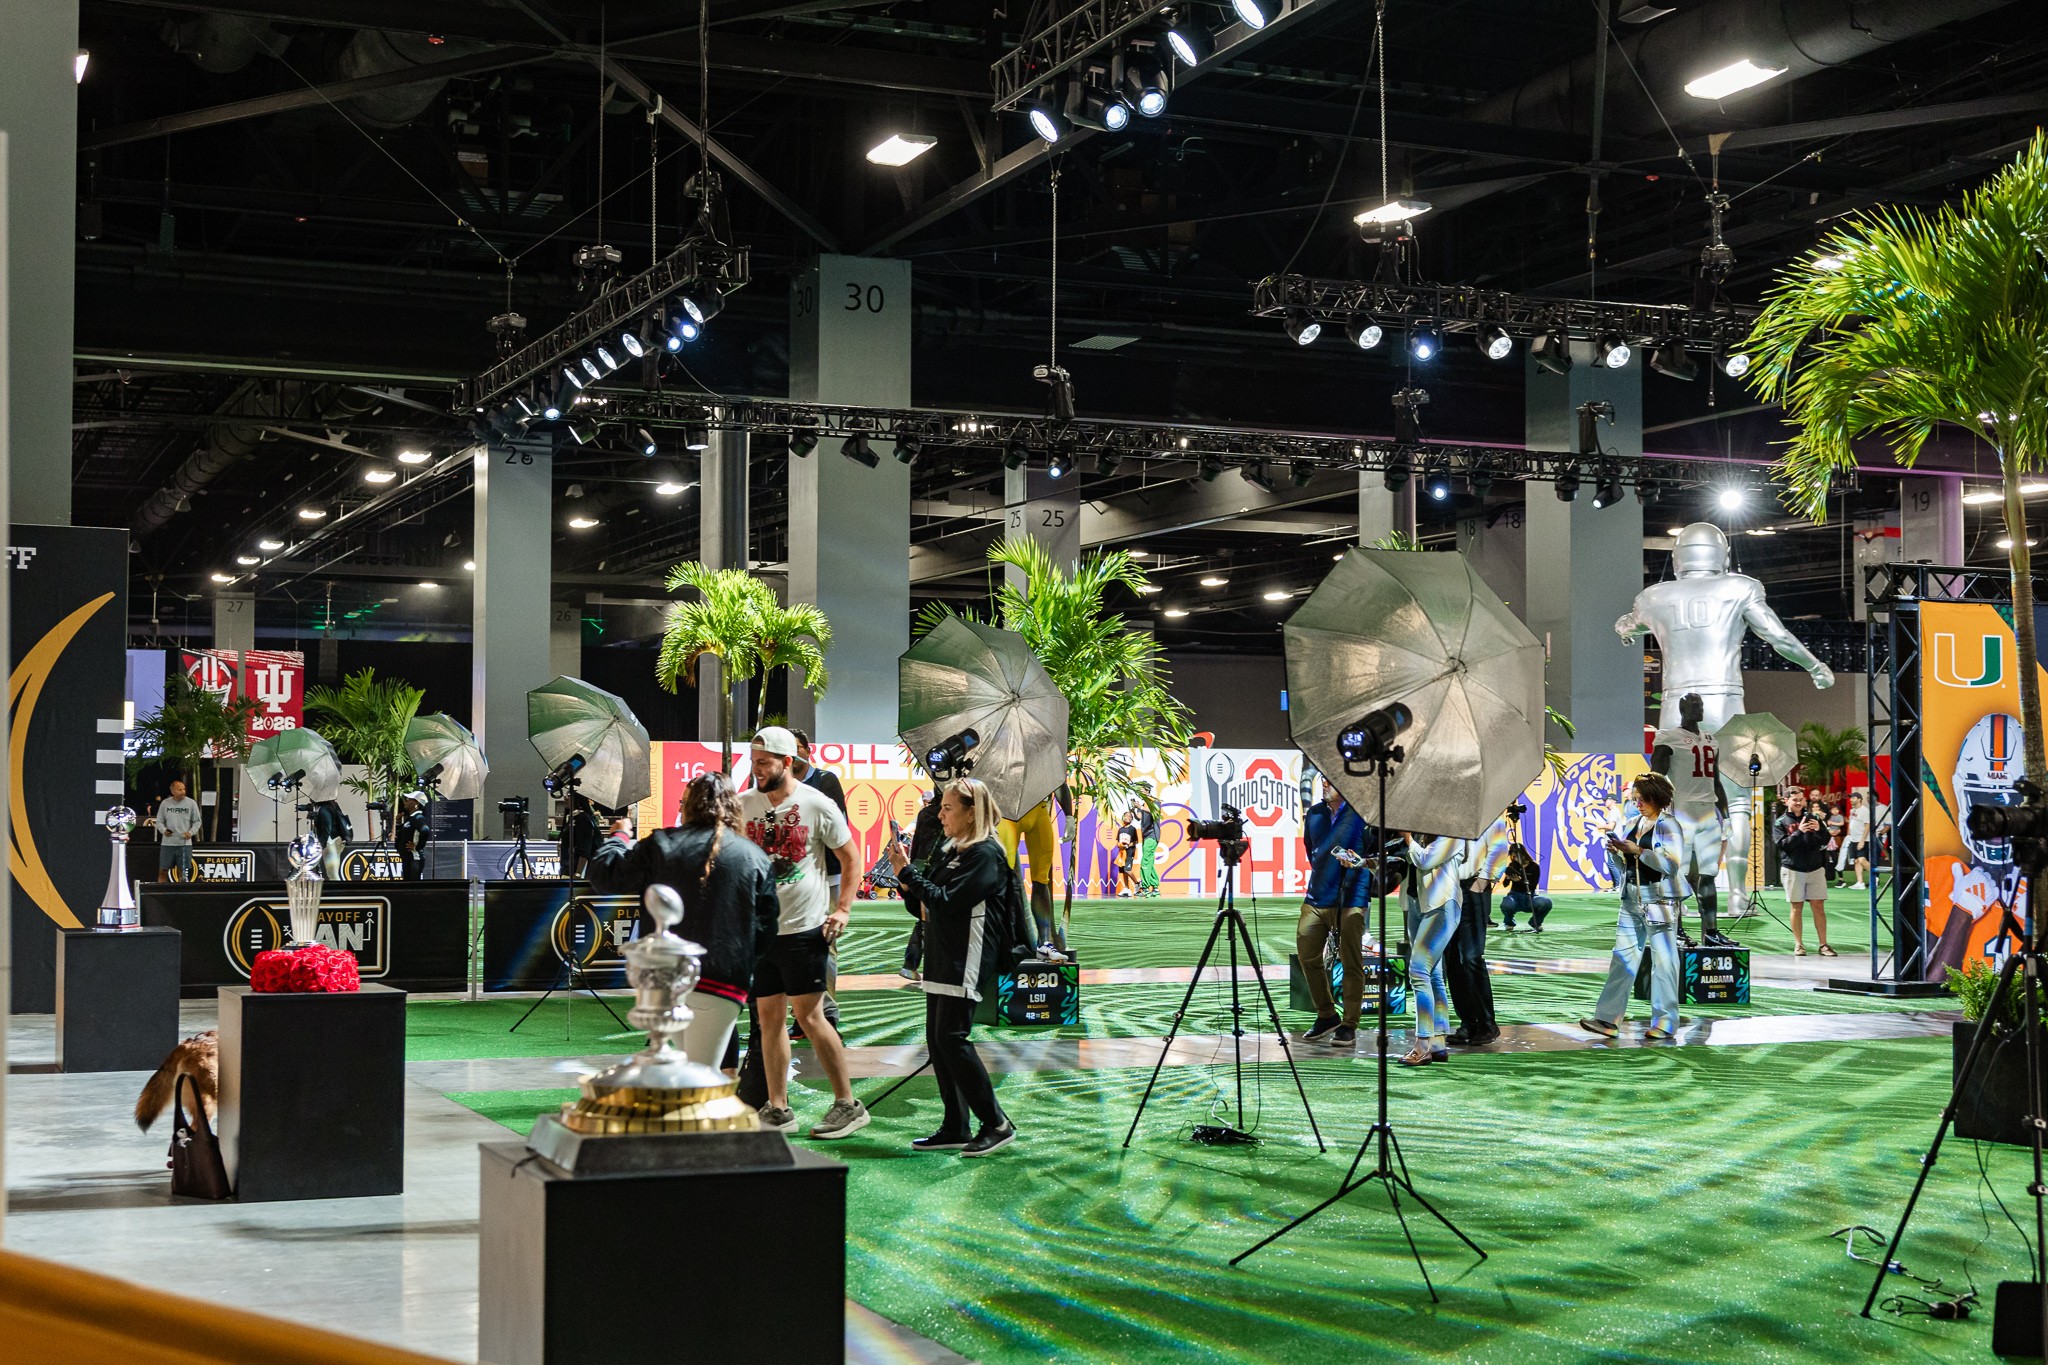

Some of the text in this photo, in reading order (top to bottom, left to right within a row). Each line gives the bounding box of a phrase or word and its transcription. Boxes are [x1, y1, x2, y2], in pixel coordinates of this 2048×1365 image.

[797, 286, 812, 317] 30
[844, 283, 885, 313] 30
[1911, 492, 1930, 512] 19
[1010, 510, 1021, 528] 25
[1042, 510, 1064, 527] 25
[1503, 513, 1520, 528] 18
[1464, 520, 1475, 536] 18
[227, 601, 243, 612] 27
[556, 611, 571, 622] 26
[1934, 633, 2003, 688] U
[1692, 745, 1714, 778] 18
[204, 863, 241, 878] FAN
[1702, 957, 1732, 970] 2018
[1017, 973, 1058, 988] 2020
[1701, 975, 1734, 983] ALABAMA
[1029, 994, 1046, 1002] LSU
